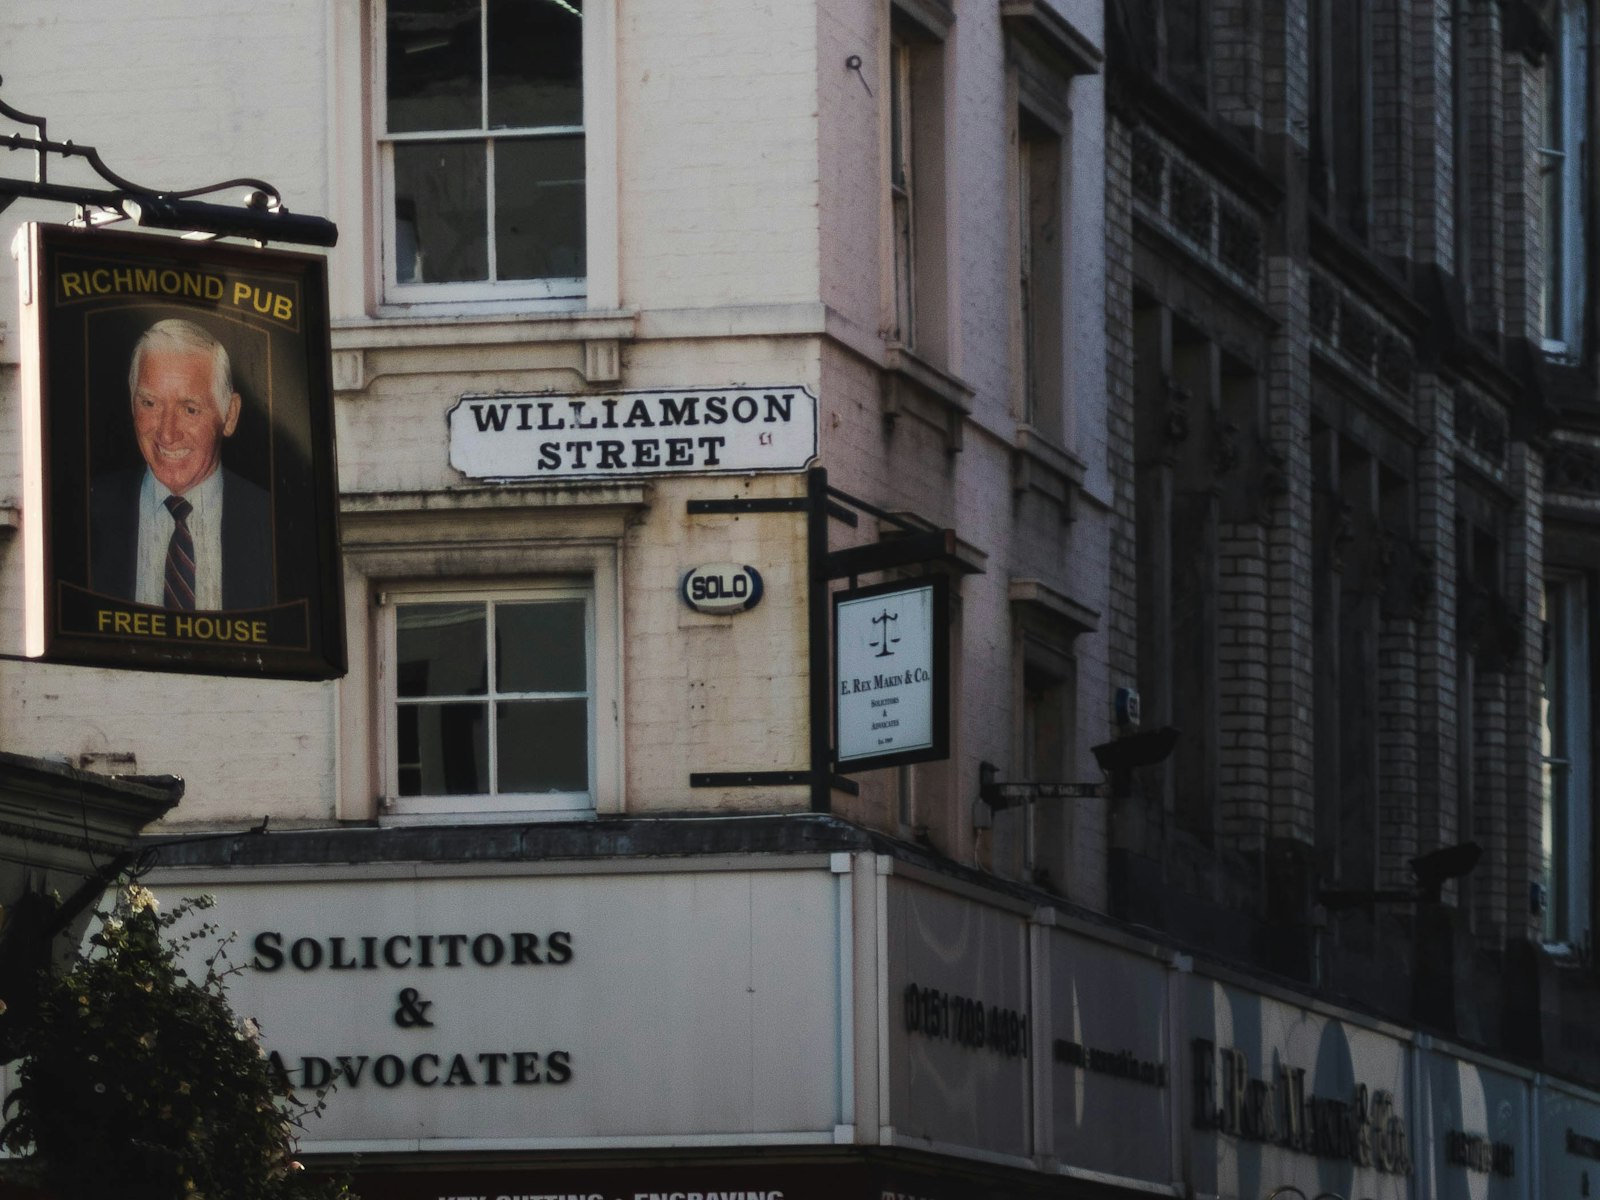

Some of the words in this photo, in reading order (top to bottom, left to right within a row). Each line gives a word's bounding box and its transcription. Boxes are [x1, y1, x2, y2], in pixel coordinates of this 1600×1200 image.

[61, 268, 224, 300] RICHMOND
[233, 281, 294, 322] PUB
[470, 394, 795, 432] WILLIAMSON
[537, 436, 726, 470] STREET
[692, 574, 748, 600] SOLO
[97, 609, 167, 637] FREE
[175, 615, 268, 643] HOUSE
[841, 681, 851, 696] E.
[853, 679, 872, 693] REX
[873, 674, 902, 690] MAKIN
[905, 669, 913, 684] &
[253, 931, 575, 973] SOLICITORS
[395, 987, 434, 1027] &
